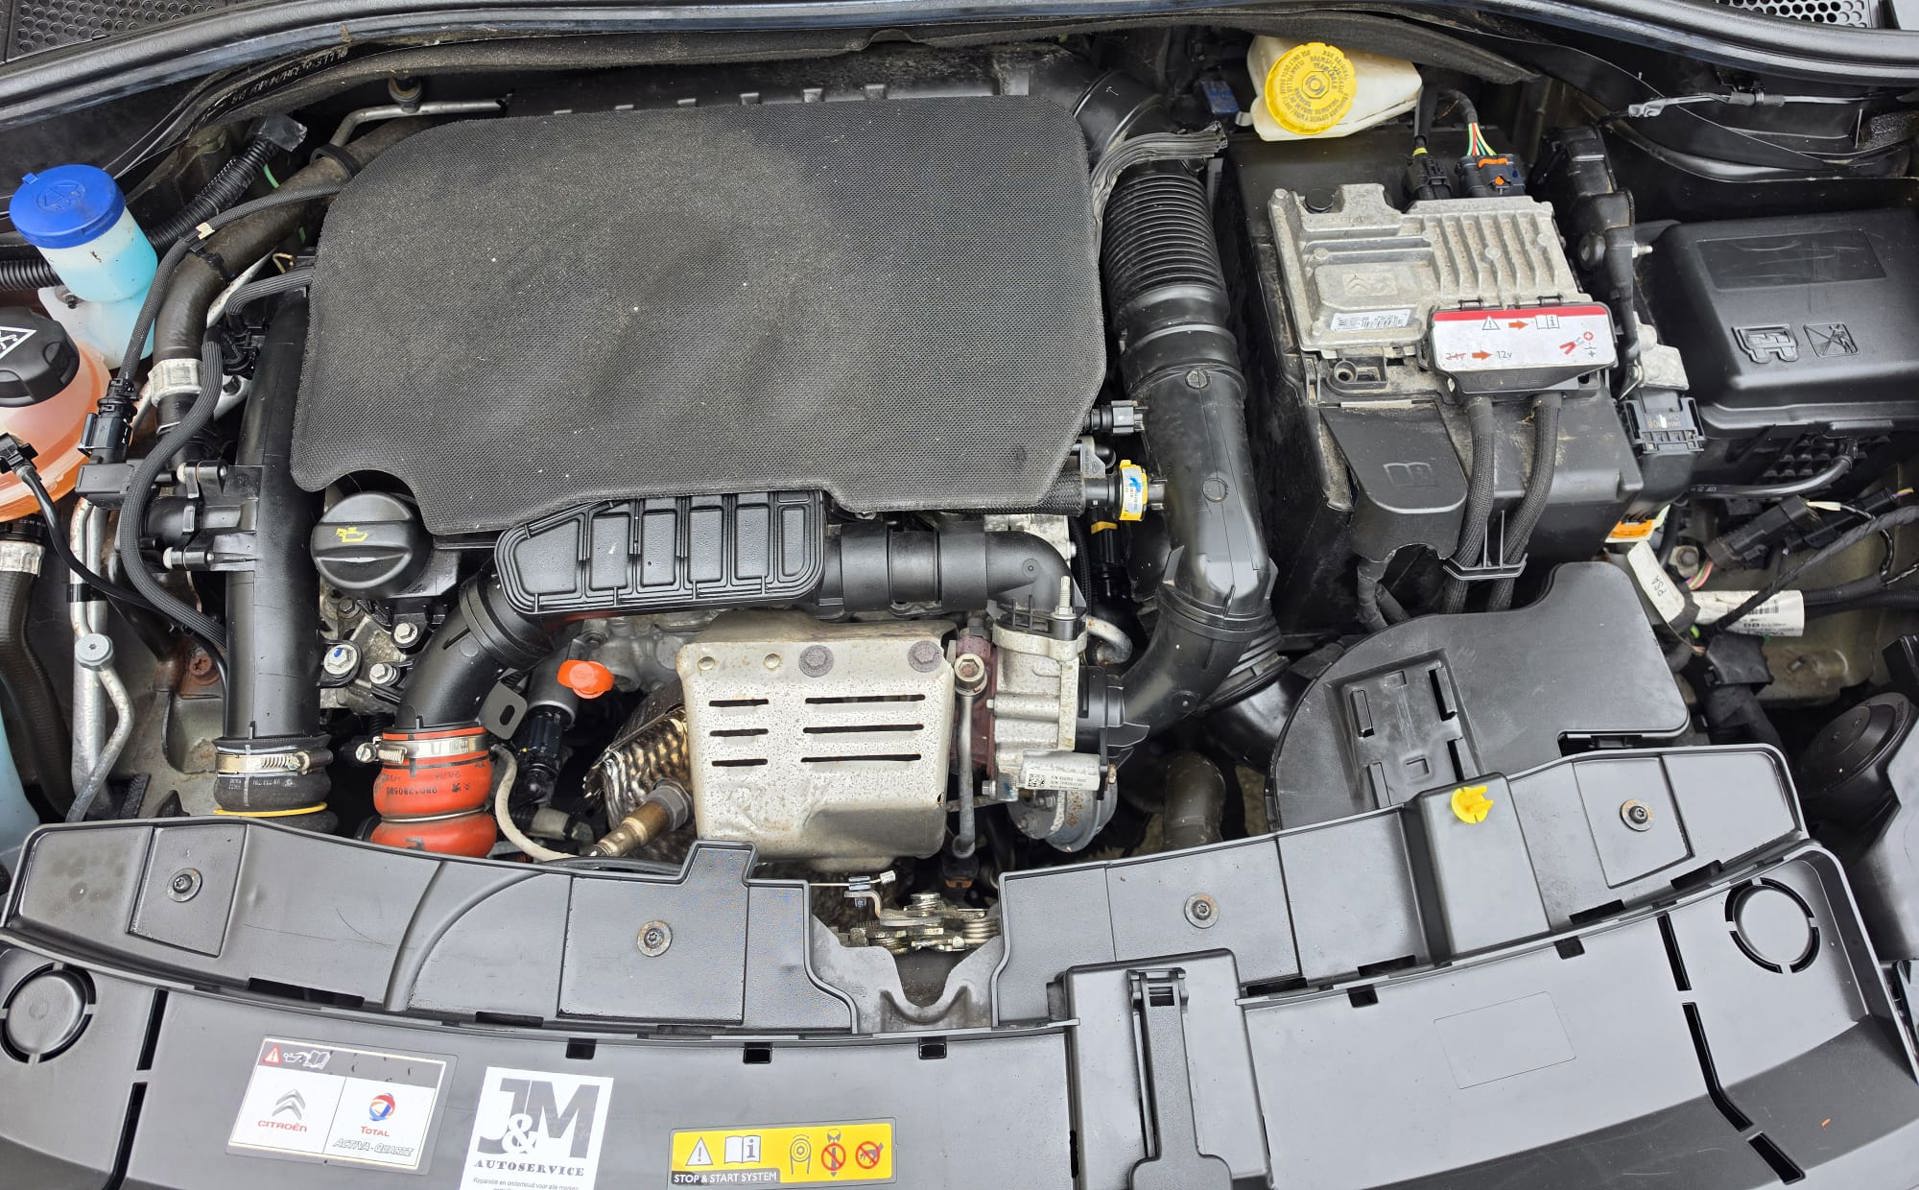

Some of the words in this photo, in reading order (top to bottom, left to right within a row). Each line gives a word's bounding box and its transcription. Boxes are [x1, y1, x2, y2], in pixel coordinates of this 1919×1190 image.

[257, 1119, 308, 1133] CITROËN
[360, 1126, 390, 1137] TOTAL
[474, 1159, 585, 1177] AUTOSERVICE
[673, 1173, 699, 1183] STOP
[700, 1173, 708, 1183] &
[709, 1172, 739, 1183] START
[741, 1171, 777, 1182] SYSTEM
